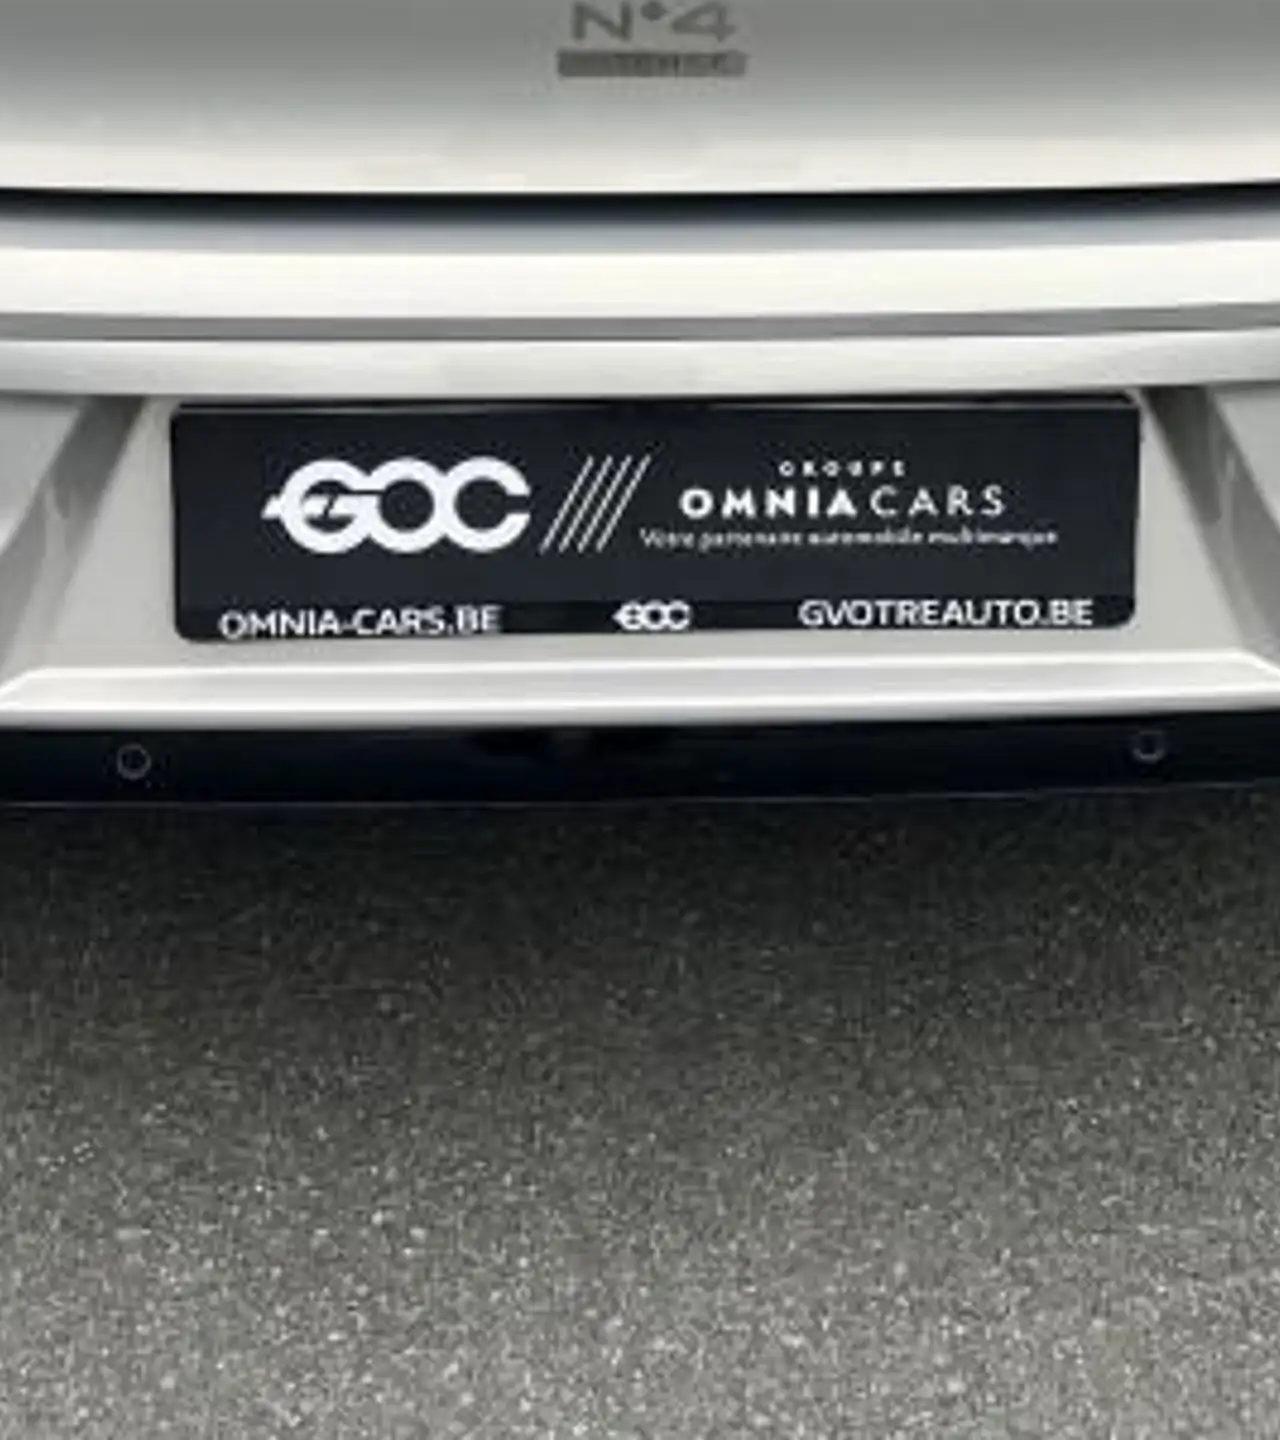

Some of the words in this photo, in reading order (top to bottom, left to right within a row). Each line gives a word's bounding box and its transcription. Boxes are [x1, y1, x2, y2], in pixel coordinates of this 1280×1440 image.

[778, 460, 907, 478] GROUPE
[261, 456, 532, 555] GOC
[218, 604, 504, 641] OMNIA-CARS.BE
[797, 598, 1094, 628] GVOTREAUTO.BE
